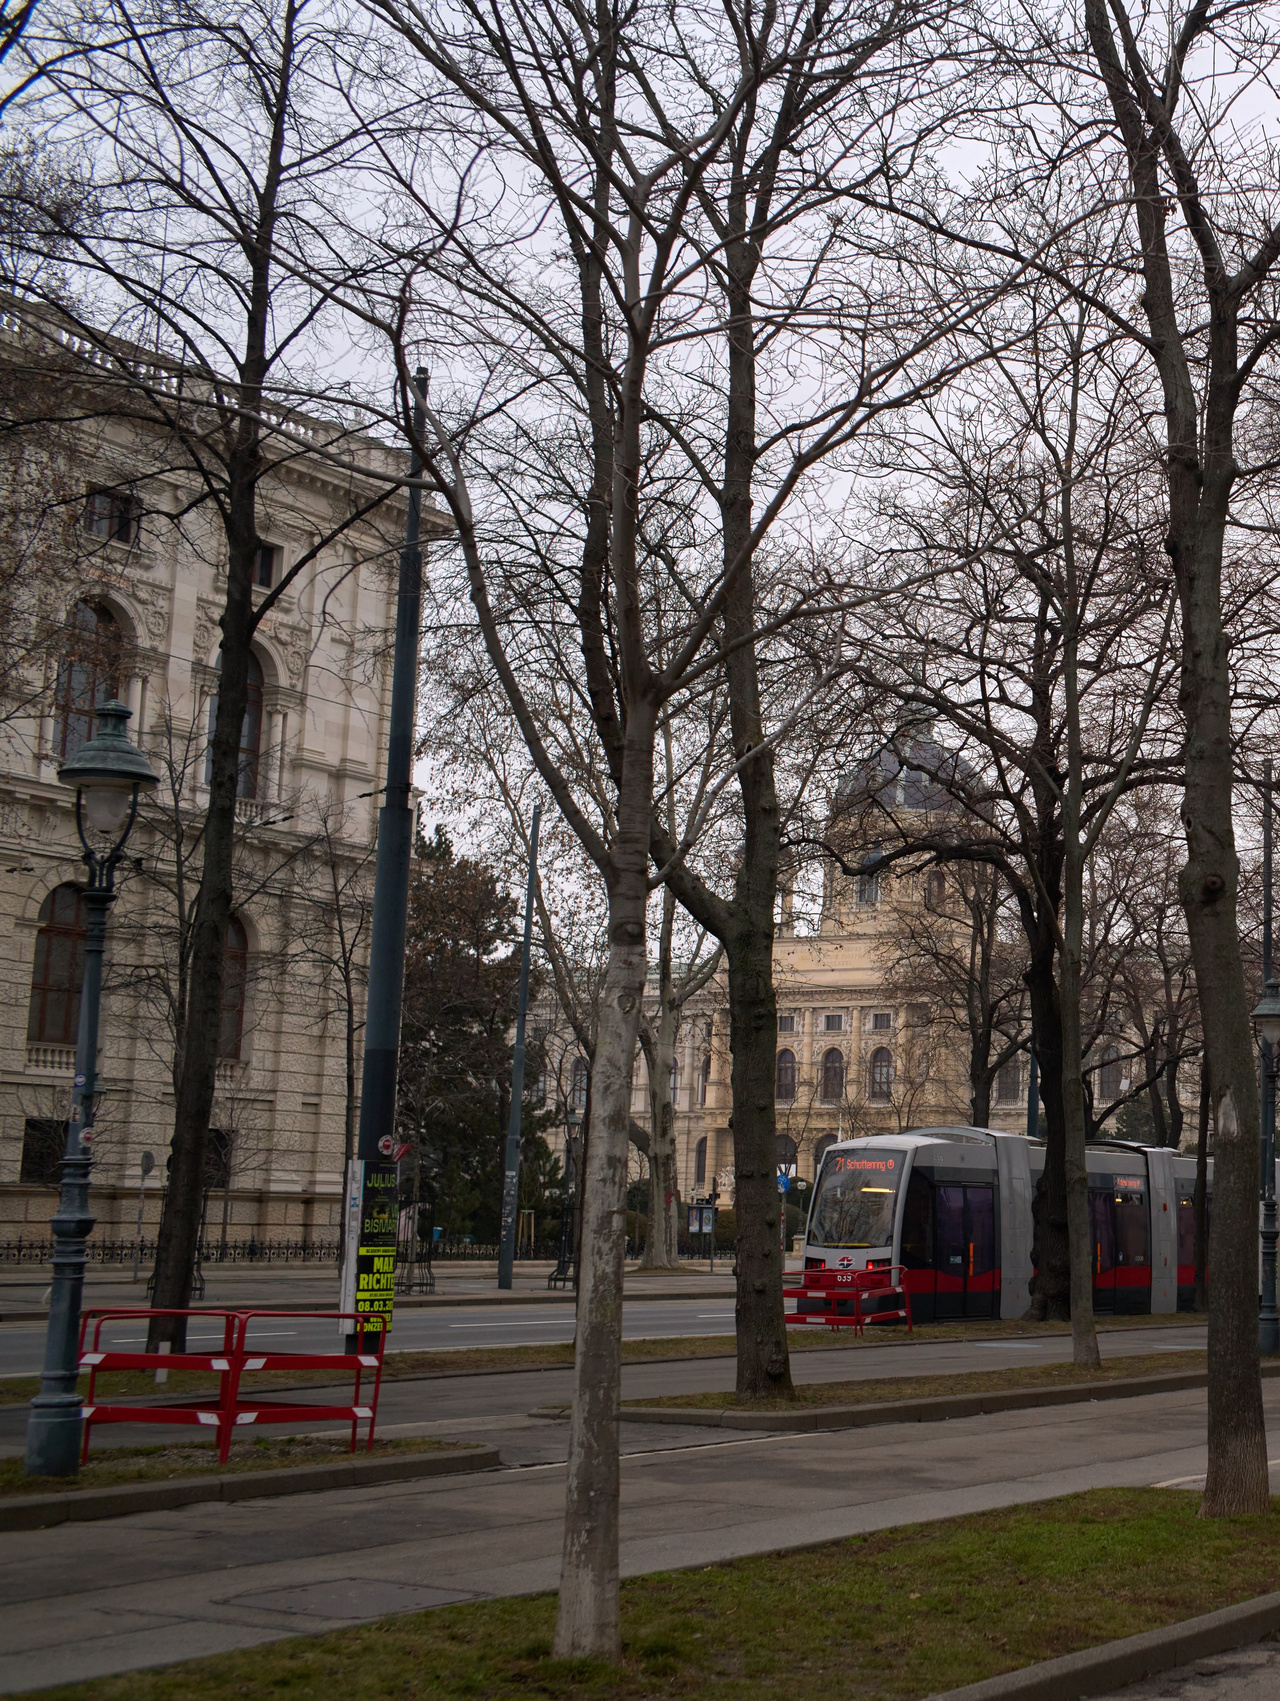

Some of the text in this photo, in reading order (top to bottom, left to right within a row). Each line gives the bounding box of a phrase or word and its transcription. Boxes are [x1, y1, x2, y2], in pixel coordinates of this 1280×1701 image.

[835, 1157, 845, 1172] 71
[846, 1159, 886, 1171] Schottenring
[366, 1173, 396, 1188] JULIUS
[364, 1219, 397, 1233] BISMAR
[373, 1257, 394, 1272] MAX
[359, 1273, 395, 1290] RICHTE
